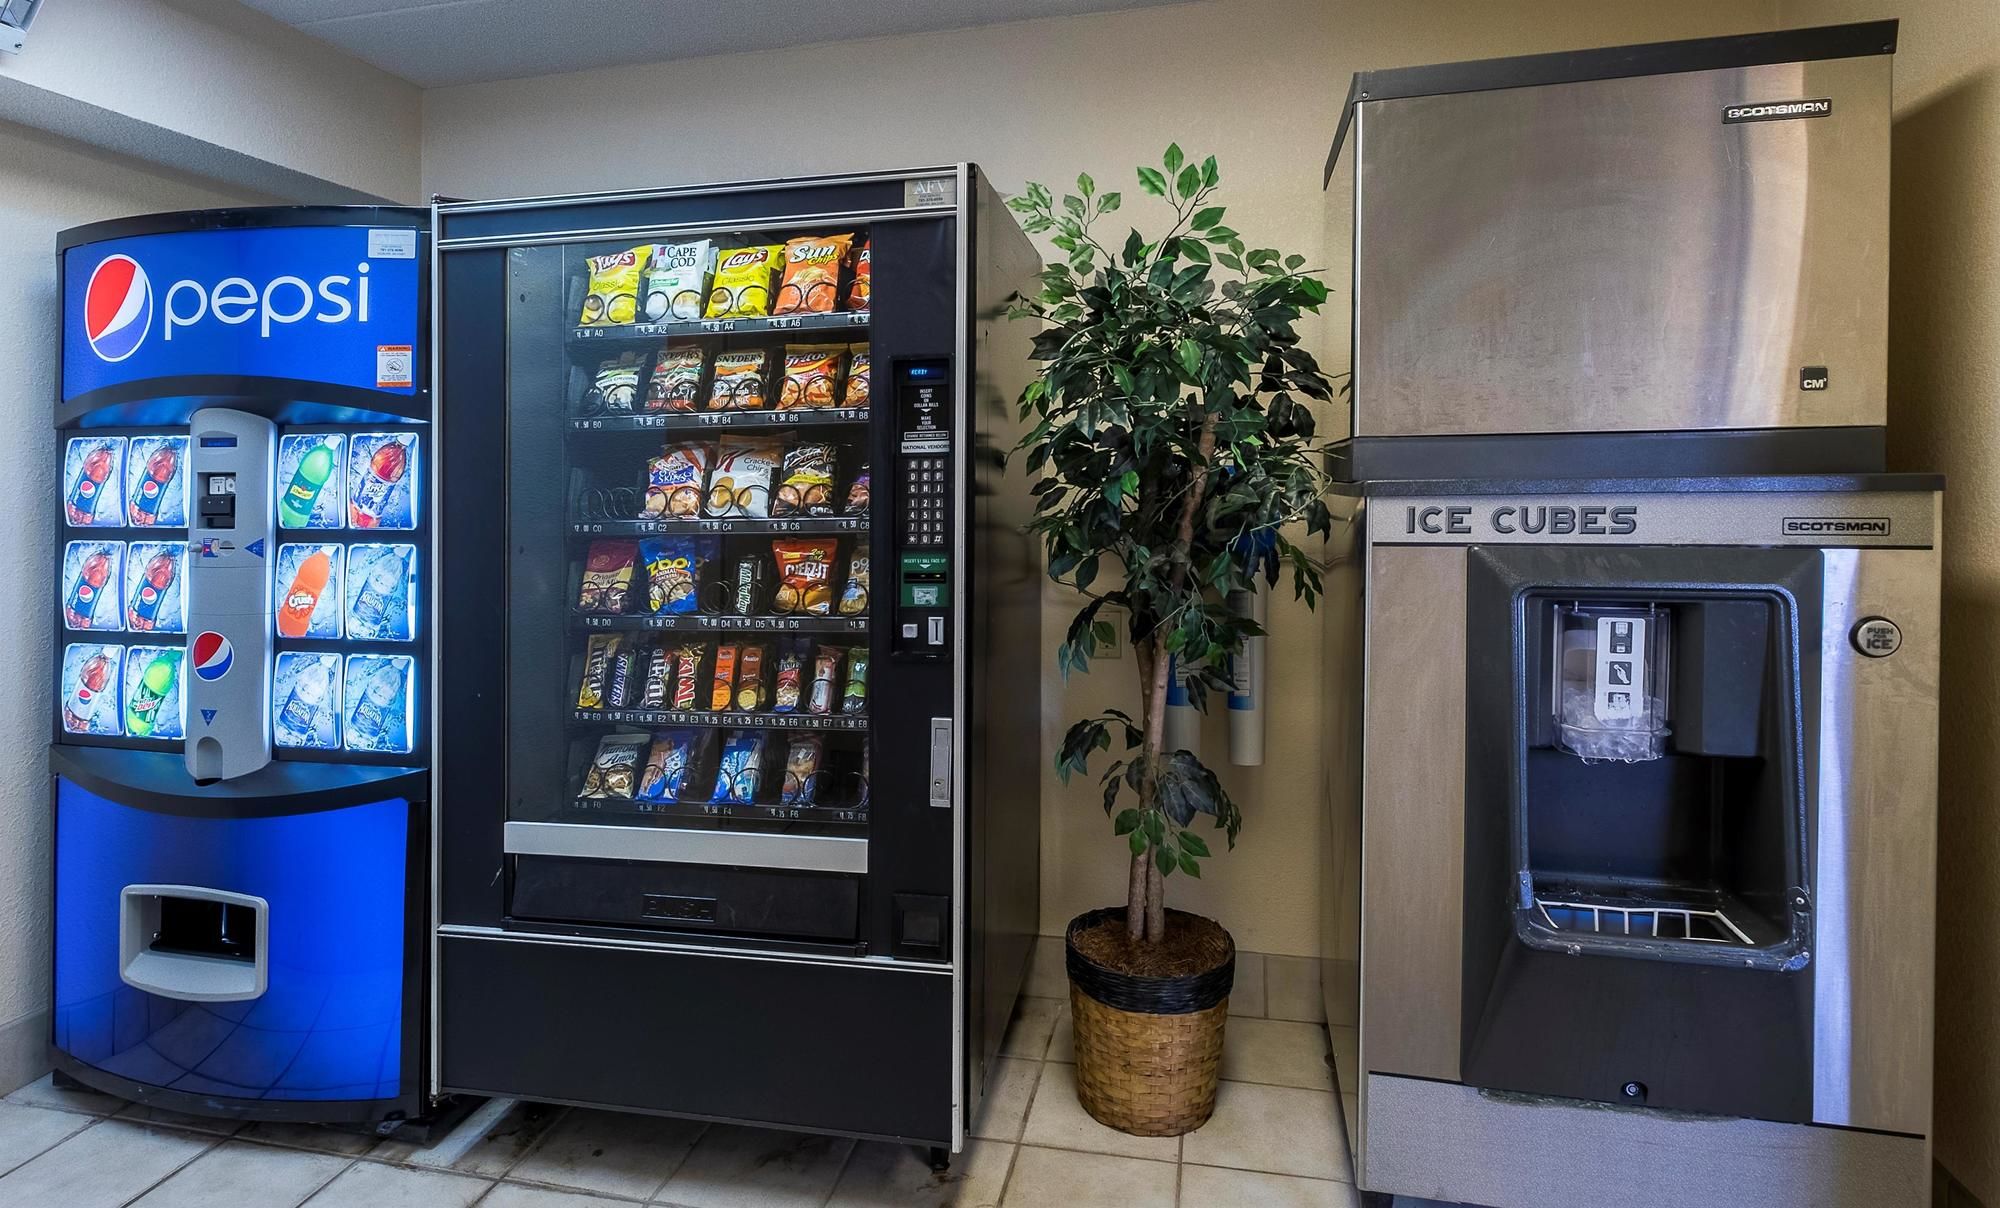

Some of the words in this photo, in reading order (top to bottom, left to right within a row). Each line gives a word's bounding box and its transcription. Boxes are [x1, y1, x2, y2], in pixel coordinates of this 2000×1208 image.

[1727, 101, 1829, 119] SCOTSMAN
[667, 246, 697, 258] CAPE
[789, 245, 836, 263] Sun
[670, 257, 696, 269] COD
[807, 253, 840, 266] Chips
[164, 261, 371, 341] pepsi
[724, 322, 734, 331] A4
[791, 319, 801, 327] A6
[786, 351, 827, 368] Fritos
[722, 416, 731, 424] B4
[789, 414, 799, 422] B6
[655, 419, 665, 427] B2
[923, 485, 928, 493] H
[910, 499, 916, 507] 1
[923, 499, 928, 507] 2
[936, 499, 941, 507] 3
[910, 511, 916, 519] 4
[923, 511, 928, 519] 5
[936, 511, 941, 519] 6
[1405, 505, 1472, 534] ICE
[1489, 505, 1638, 534] CUBES
[722, 523, 732, 531] C4
[790, 522, 800, 531] C6
[860, 522, 870, 530] C8
[910, 523, 916, 531] 7
[923, 523, 928, 531] 8
[936, 523, 941, 531] 9
[1787, 522, 1886, 532] SCOTSMAN
[645, 557, 689, 577] ZOO
[721, 620, 731, 628] D4
[755, 620, 765, 628] D5
[850, 620, 866, 629] $1.50
[1866, 627, 1894, 635] PUSH
[1866, 639, 1893, 650] ICE
[626, 713, 634, 721] E1
[657, 714, 667, 722] E2
[690, 715, 699, 723] E3
[722, 716, 732, 725] E4
[754, 716, 764, 725] E5
[789, 717, 798, 726] E6
[823, 719, 832, 727] E7
